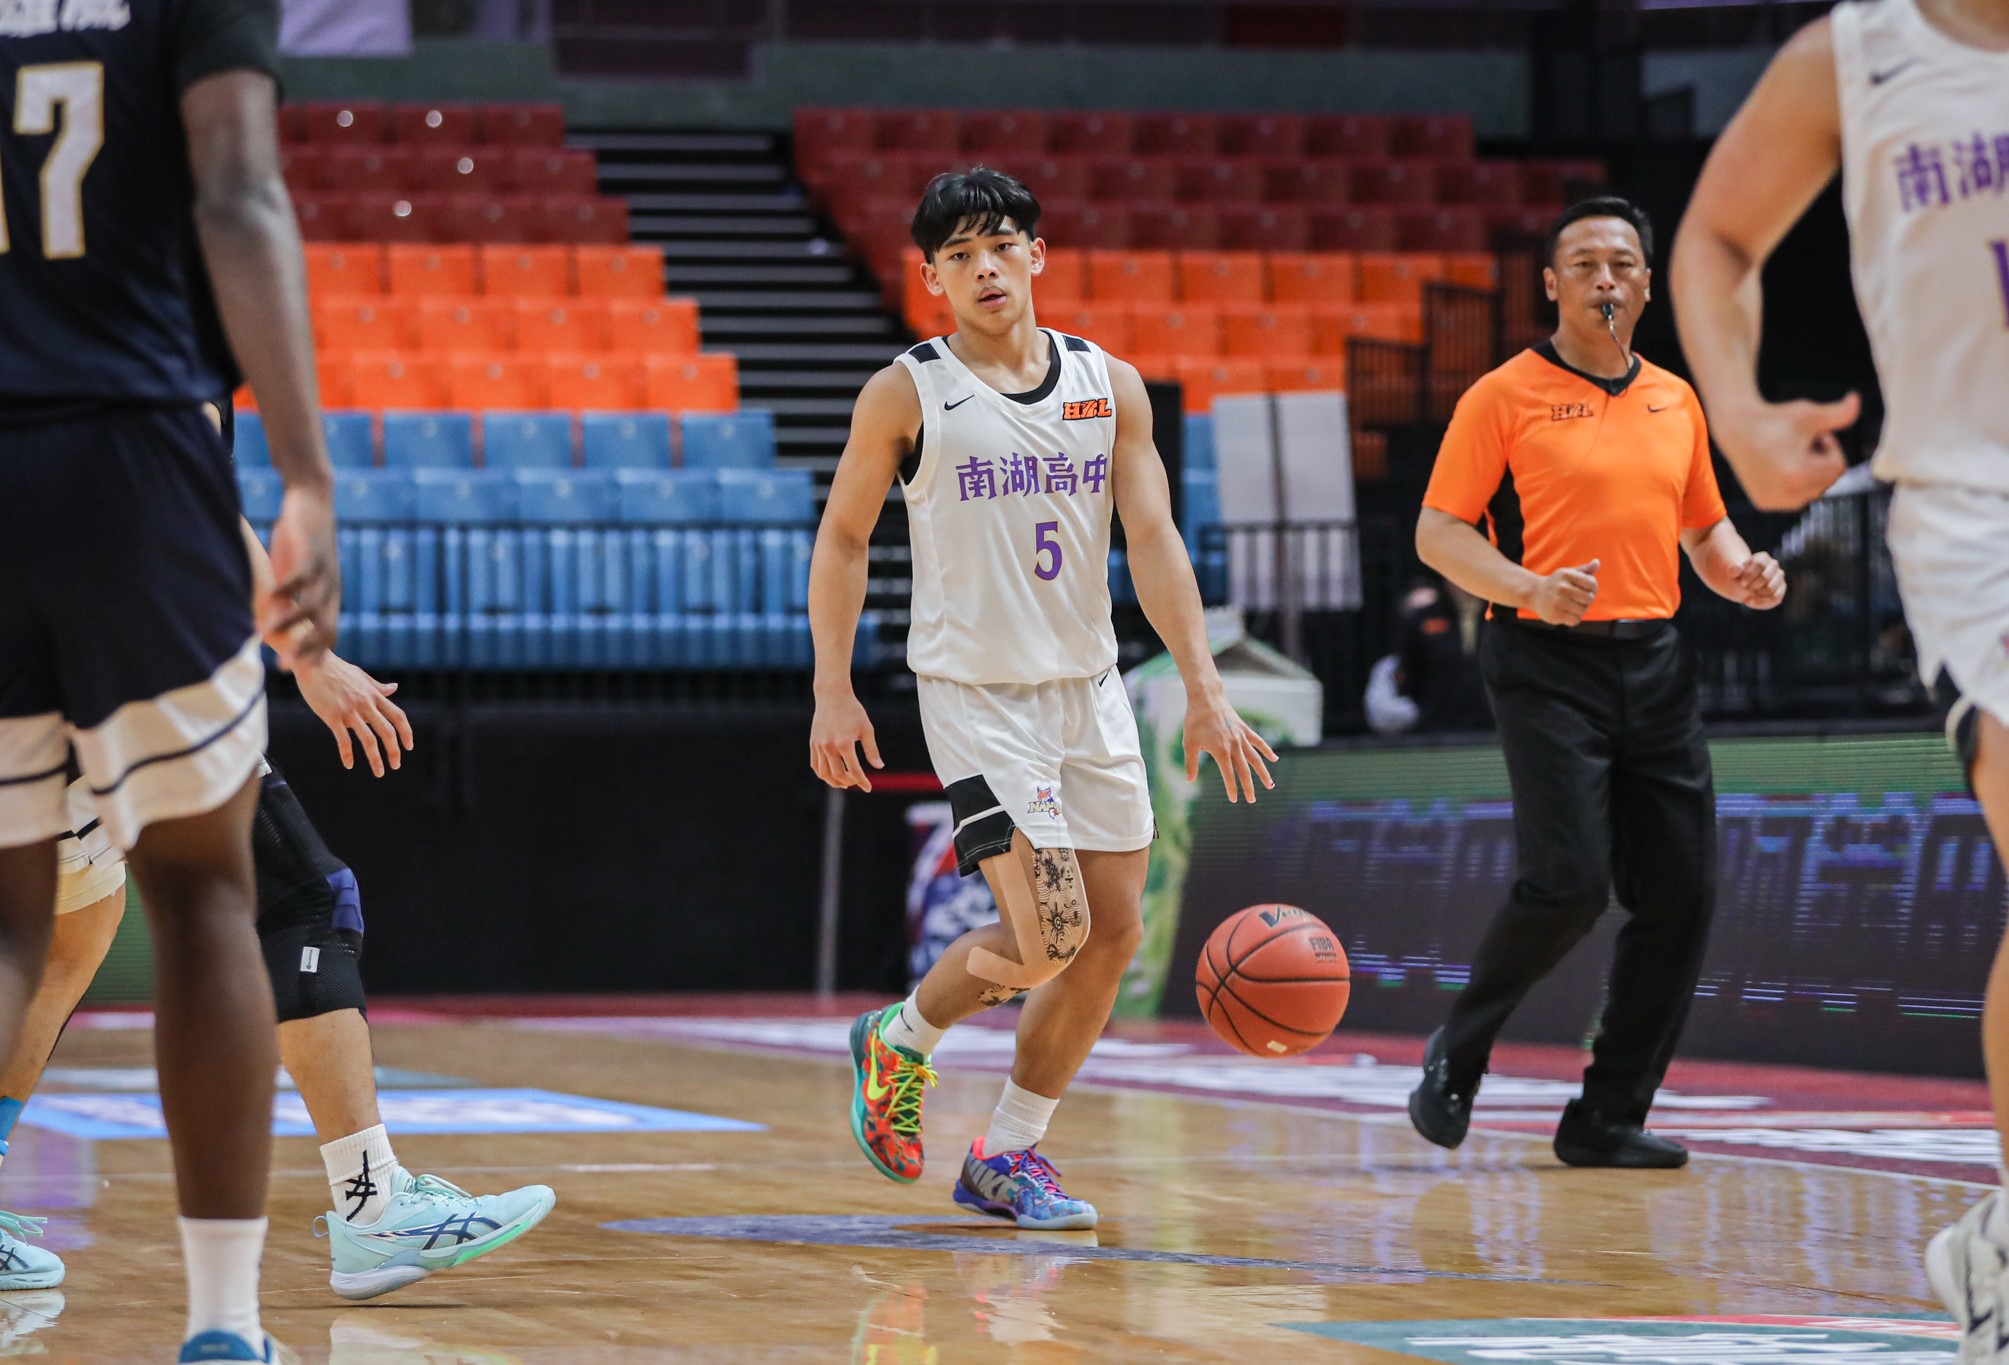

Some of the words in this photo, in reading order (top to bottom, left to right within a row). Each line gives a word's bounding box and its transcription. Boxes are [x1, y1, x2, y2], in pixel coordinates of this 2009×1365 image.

[0, 60, 105, 261] 7
[955, 452, 1108, 501] 南湖高中
[1034, 521, 1062, 581] 5
[1309, 936, 1334, 951] FIBA
